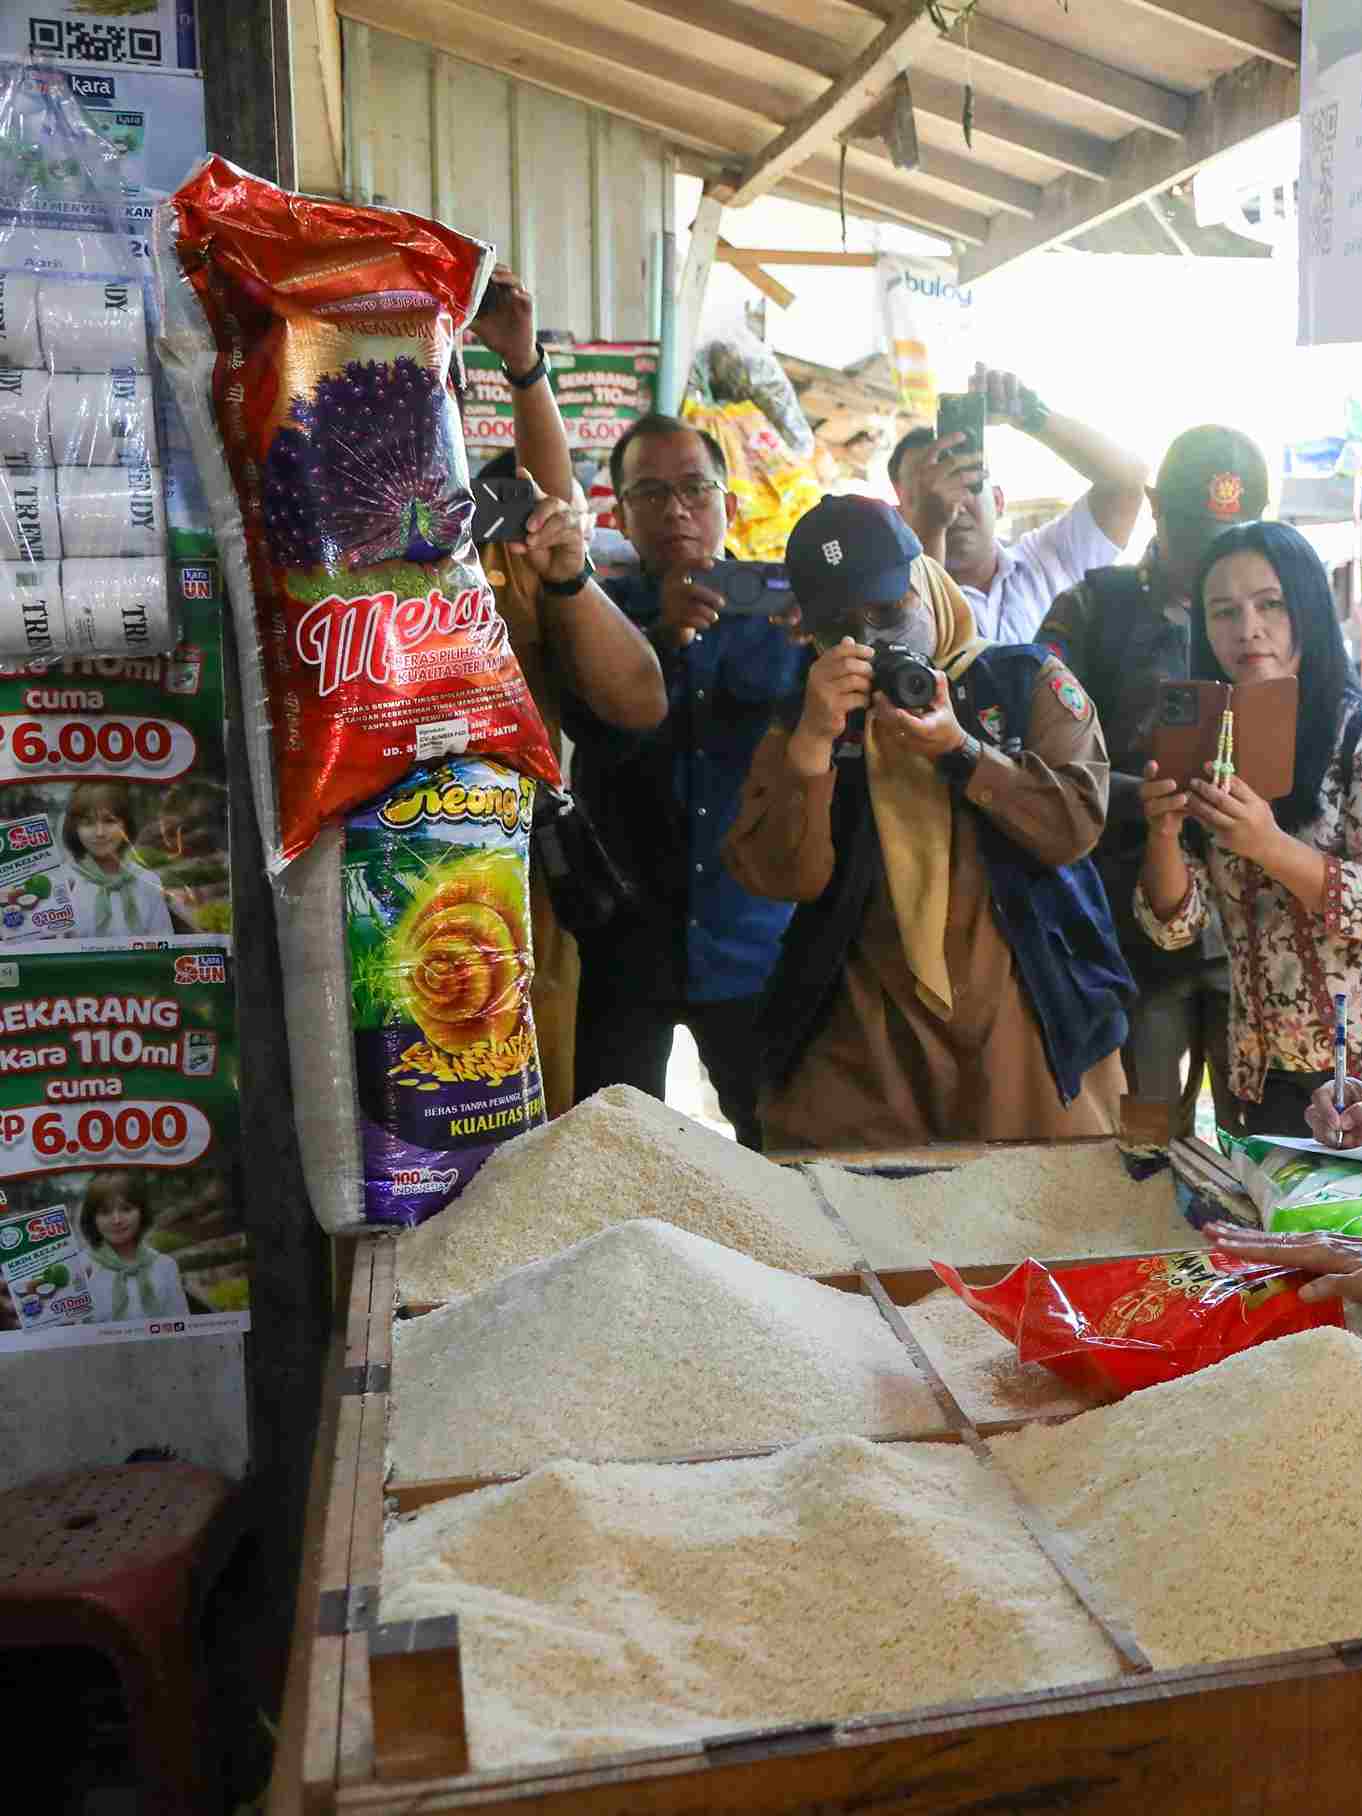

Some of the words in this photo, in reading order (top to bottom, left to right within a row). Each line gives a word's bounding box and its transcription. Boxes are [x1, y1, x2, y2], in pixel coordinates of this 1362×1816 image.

[72, 76, 112, 96] kara
[397, 662, 464, 683] KUALITAS
[26, 687, 104, 710] cuma
[12, 721, 173, 764] 6.000
[0, 999, 179, 1032] EKARANG
[73, 1030, 178, 1065] 110ml
[46, 1077, 123, 1099] cuma
[423, 1104, 459, 1118] BERAS
[460, 1100, 489, 1113] TANPA
[450, 1107, 523, 1137] KUALITAS
[32, 1106, 188, 1154] 6.000
